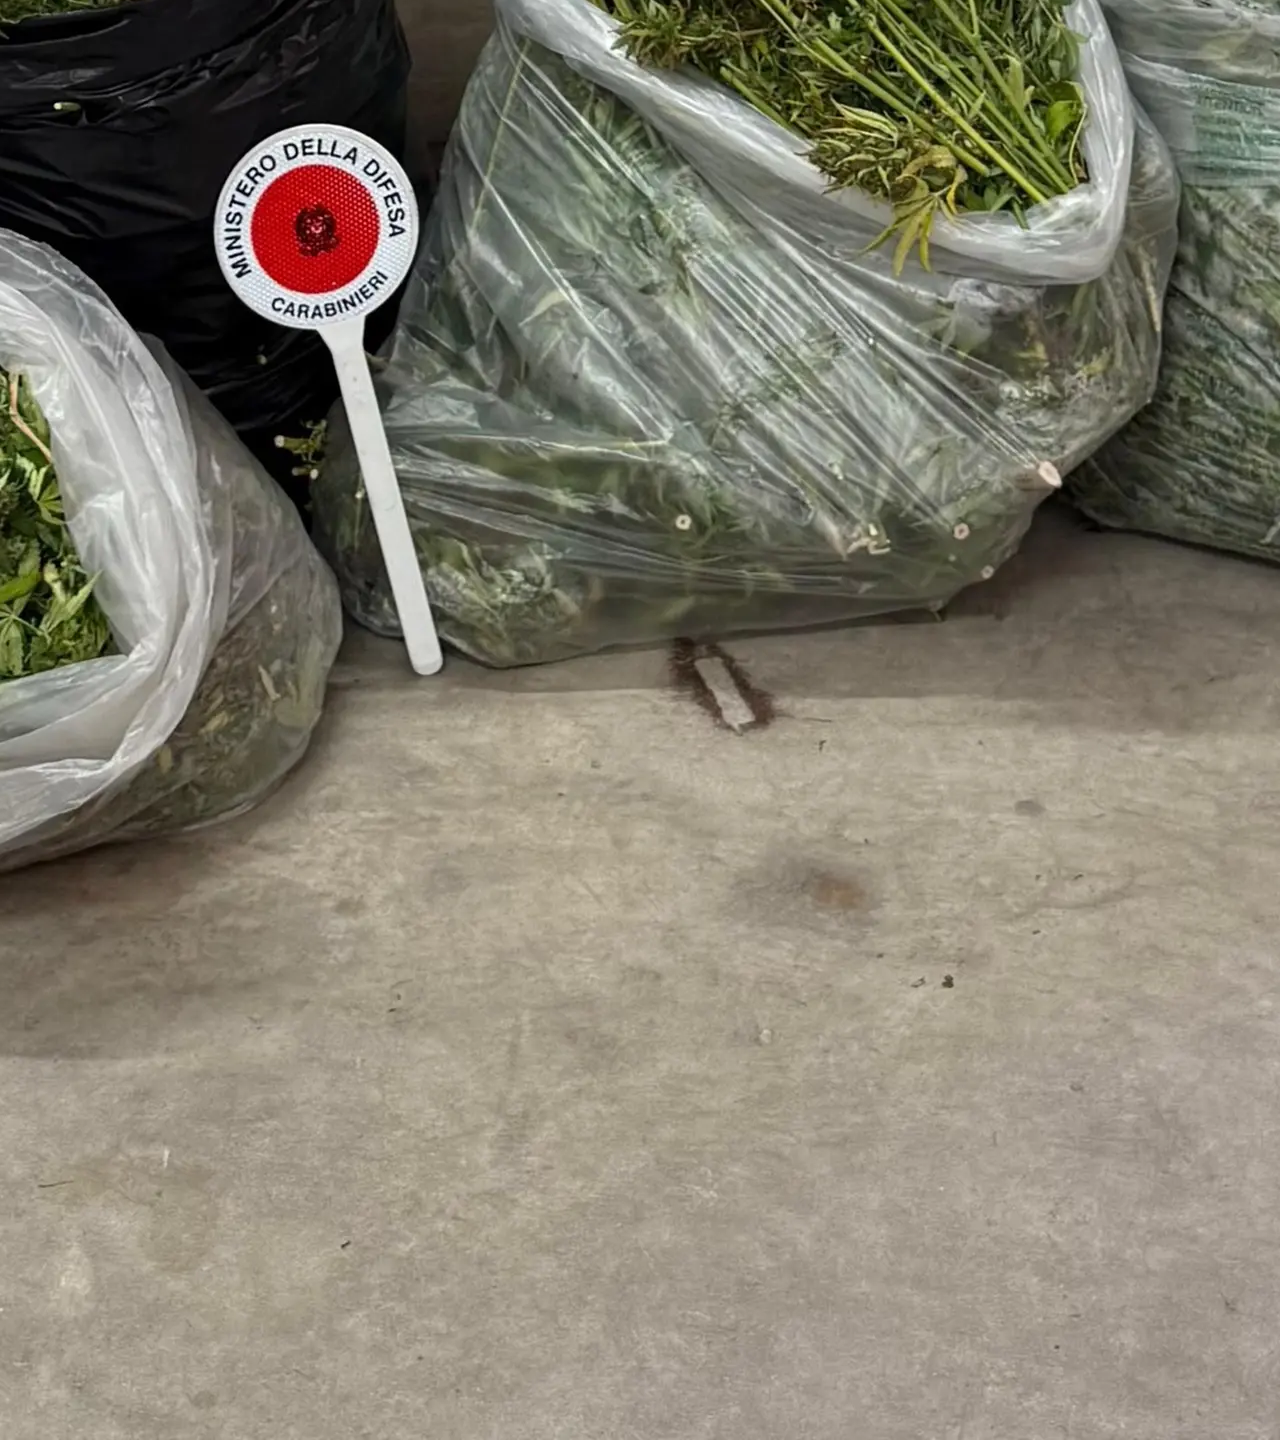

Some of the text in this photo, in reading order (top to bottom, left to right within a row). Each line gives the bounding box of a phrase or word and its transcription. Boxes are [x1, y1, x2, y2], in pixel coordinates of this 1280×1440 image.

[225, 138, 406, 279] MINISTERO DELLA DIFESA
[271, 270, 388, 319] CARABINIERI
